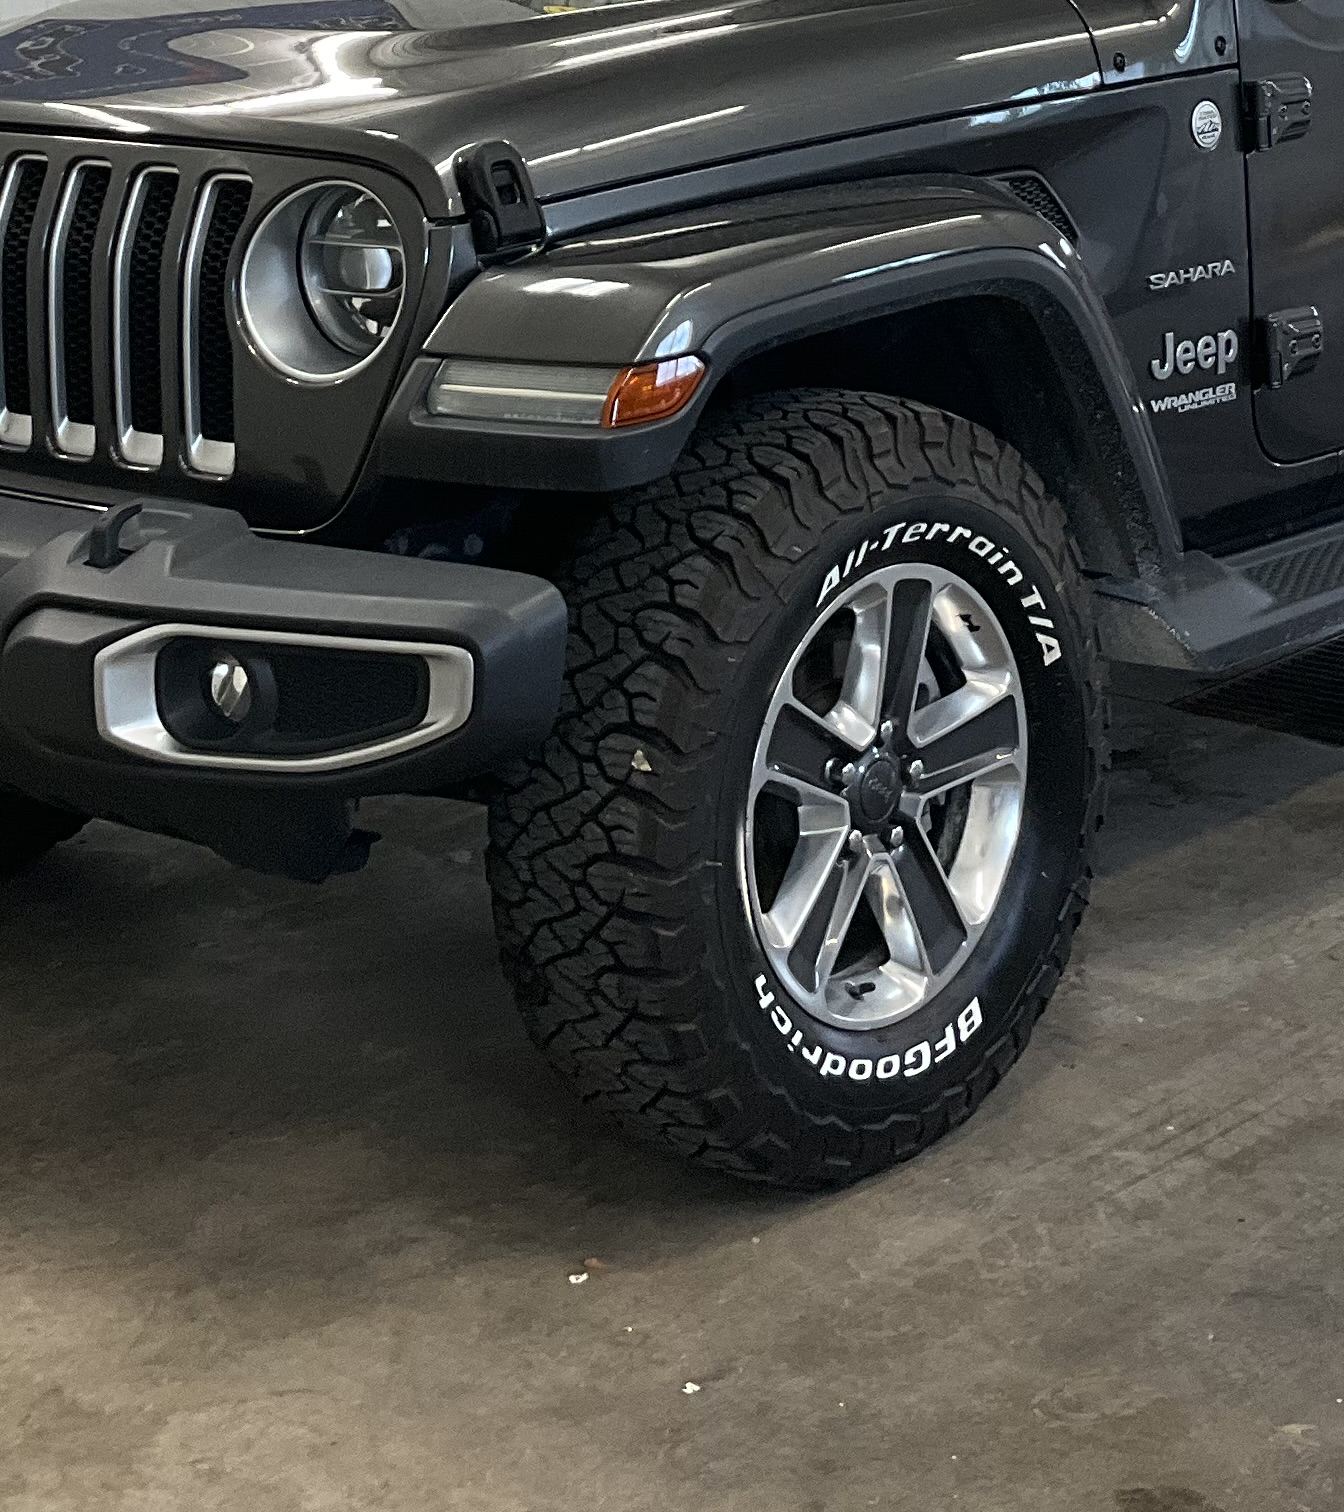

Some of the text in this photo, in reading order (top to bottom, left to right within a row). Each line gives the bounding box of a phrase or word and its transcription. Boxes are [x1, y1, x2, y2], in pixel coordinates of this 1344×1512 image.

[1148, 259, 1235, 290] SAHARA
[1151, 329, 1238, 380] Jeep
[1150, 382, 1236, 413] WRANGLER
[815, 517, 1062, 667] All-Terrain T/A
[753, 973, 984, 1082] BFGoodrich
